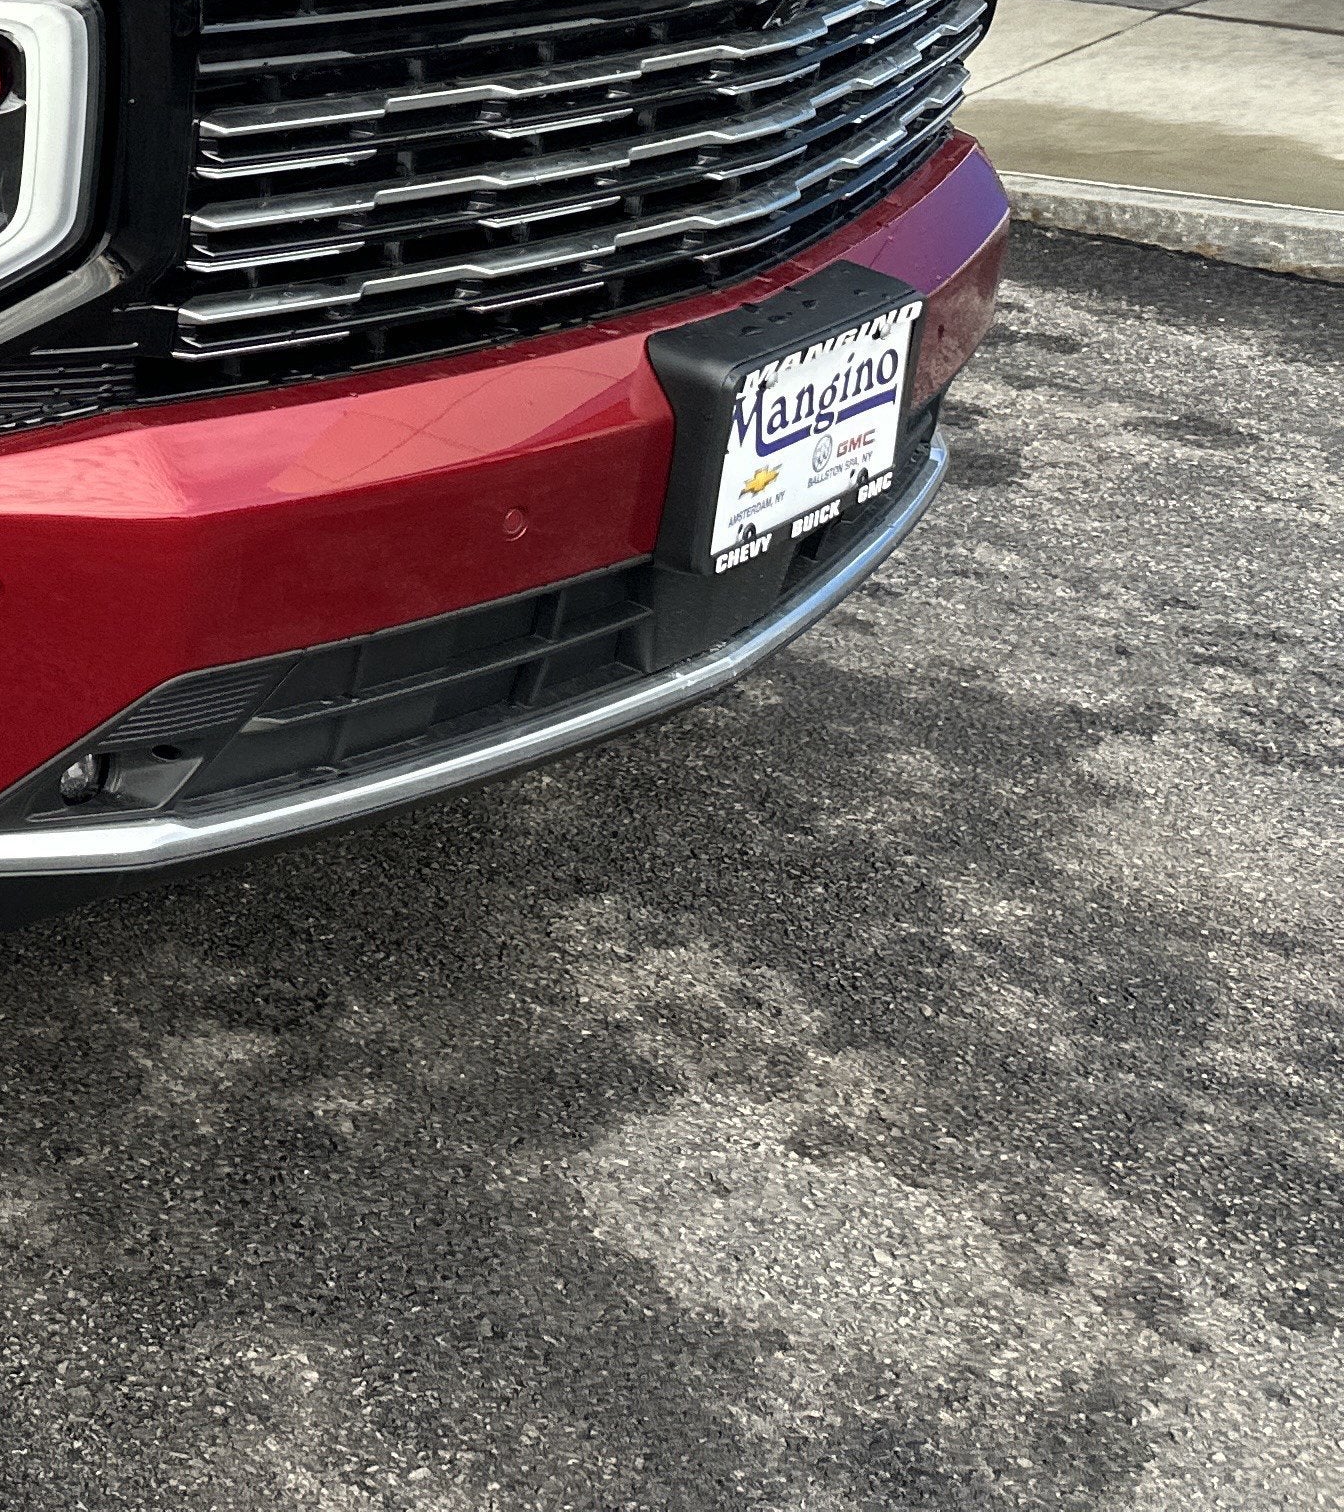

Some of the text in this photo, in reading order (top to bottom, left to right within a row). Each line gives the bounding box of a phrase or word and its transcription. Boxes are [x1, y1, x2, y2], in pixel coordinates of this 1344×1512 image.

[732, 348, 899, 450] Mangino
[807, 463, 844, 488] BALLSTON
[861, 450, 873, 463] NY
[836, 428, 876, 458] GMC
[715, 471, 893, 574] CHEVY BUICK GMC
